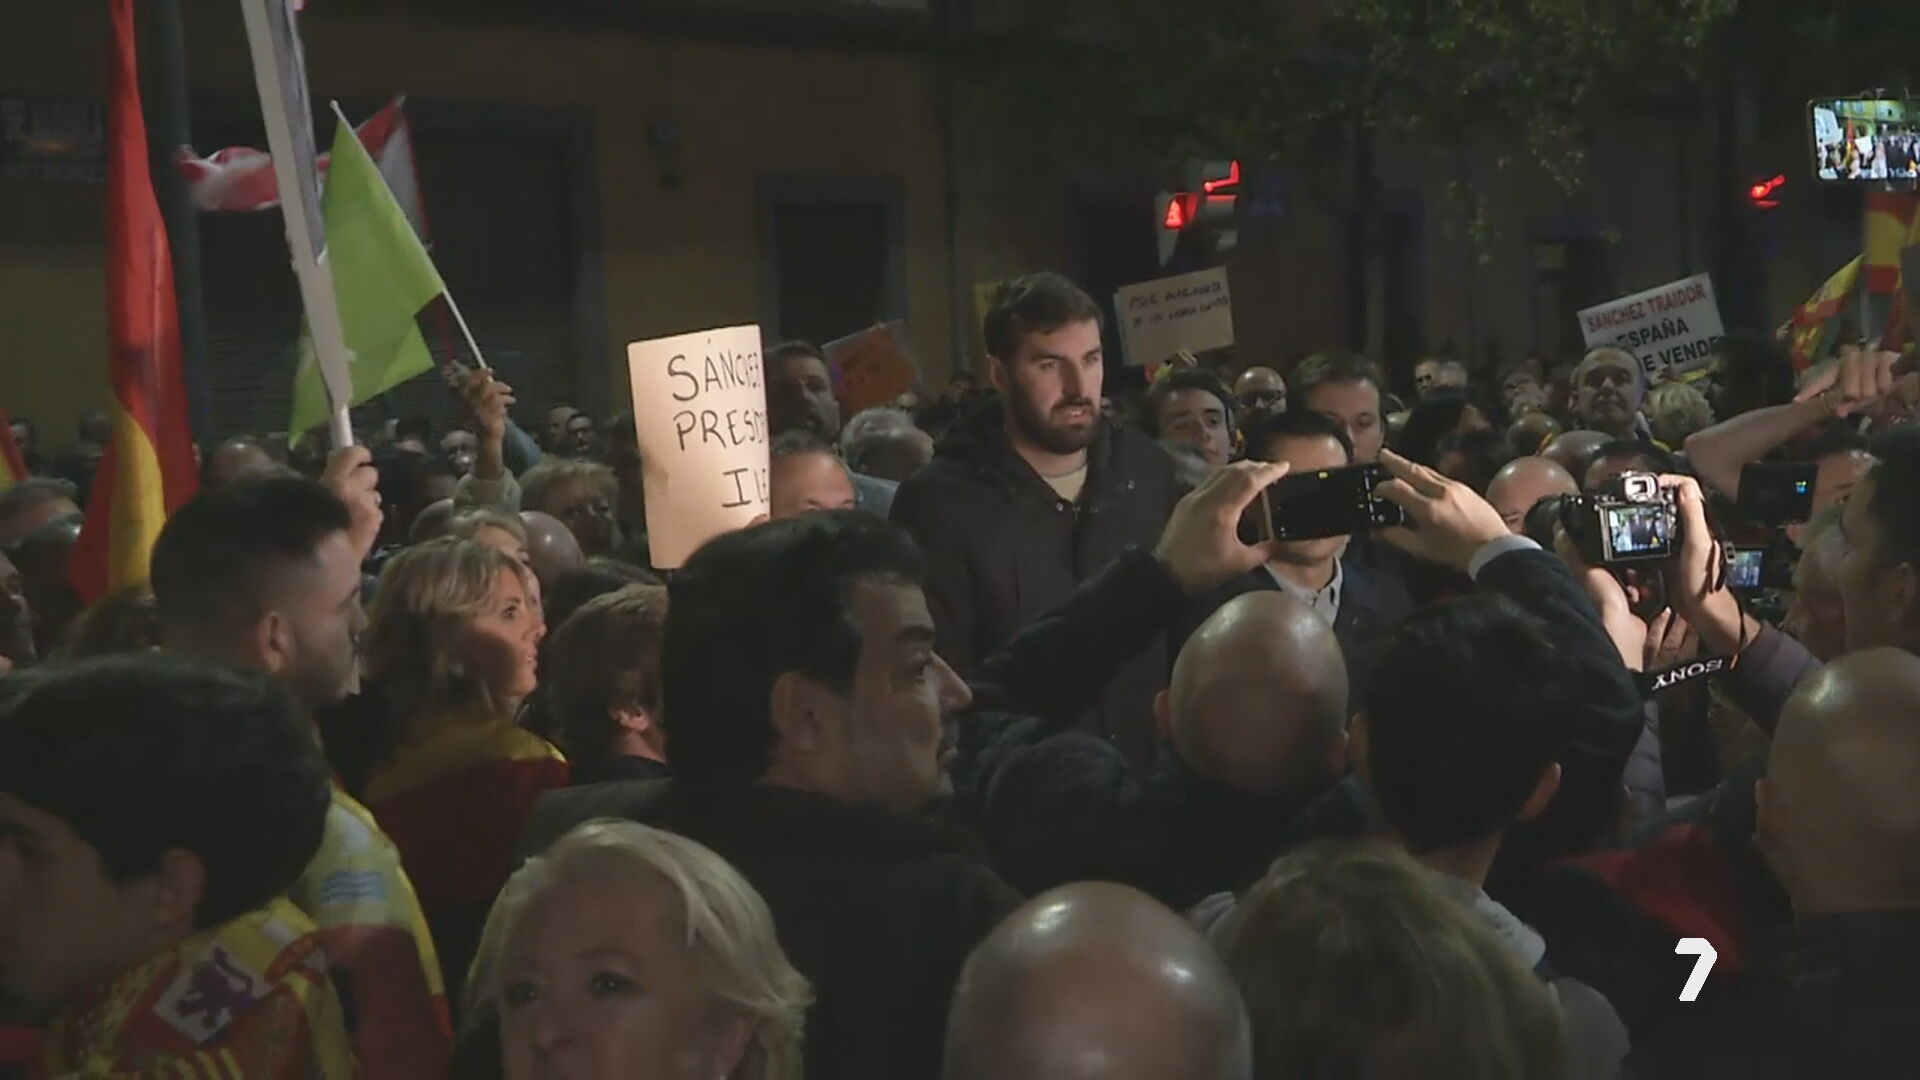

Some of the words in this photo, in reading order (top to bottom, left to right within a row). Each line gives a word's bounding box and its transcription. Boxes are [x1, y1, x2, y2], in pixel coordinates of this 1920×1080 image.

[1587, 302, 1646, 333] SANCHEZ
[1647, 283, 1706, 313] TRAIDOR
[1651, 658, 1724, 692] SONY
